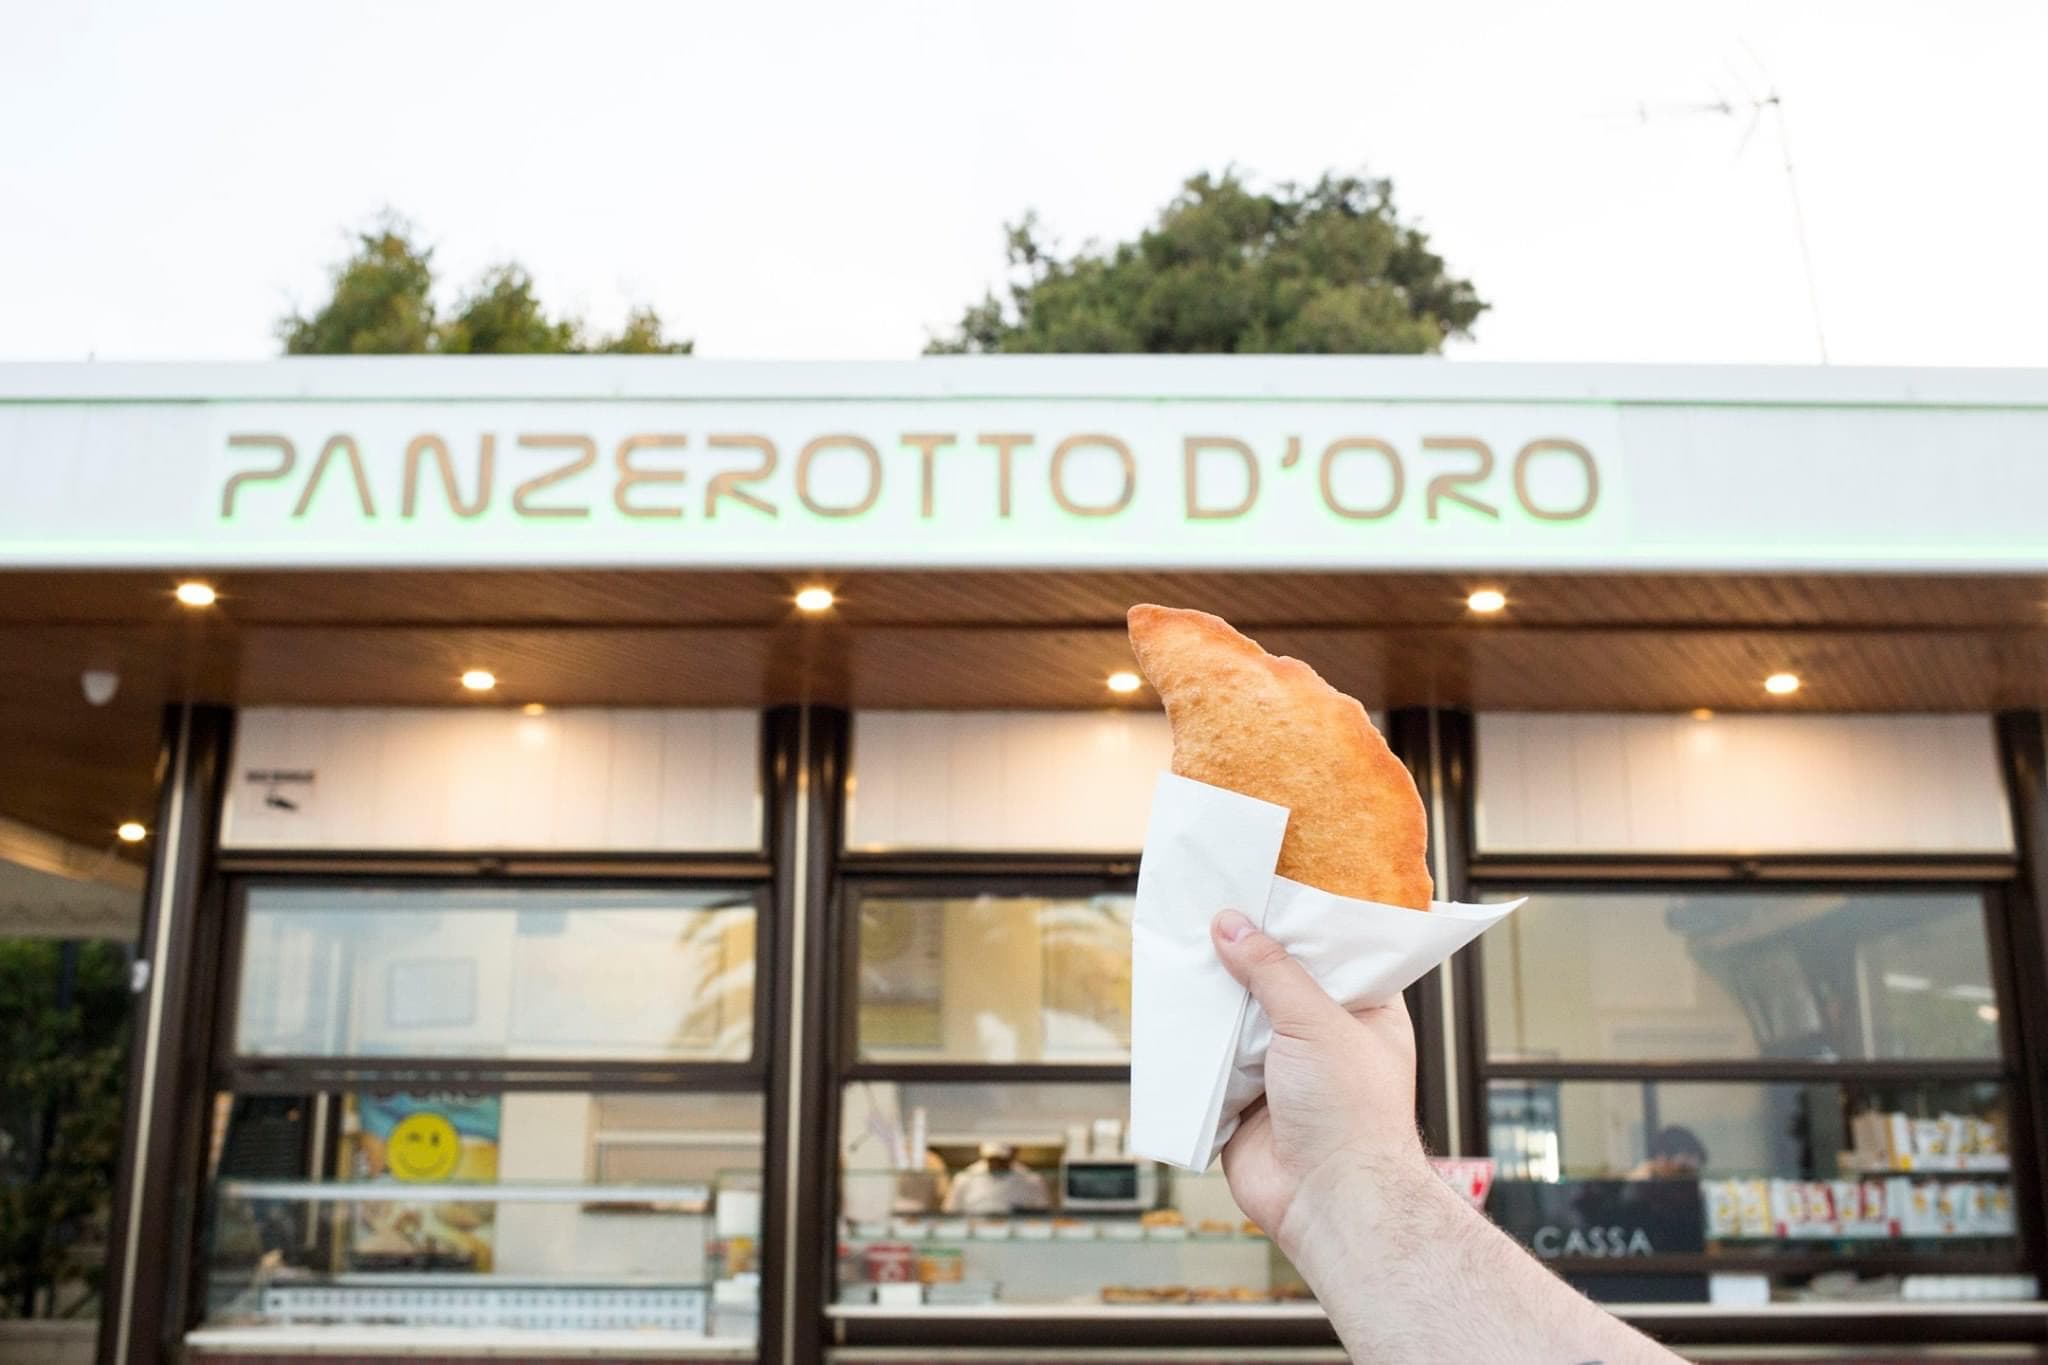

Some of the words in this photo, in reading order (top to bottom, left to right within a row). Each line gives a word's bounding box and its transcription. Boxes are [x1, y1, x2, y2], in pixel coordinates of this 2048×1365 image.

[220, 433, 1137, 518] PANZEROTTO
[1183, 435, 1601, 521] D'ORO
[1533, 1225, 1654, 1259] CASSA
